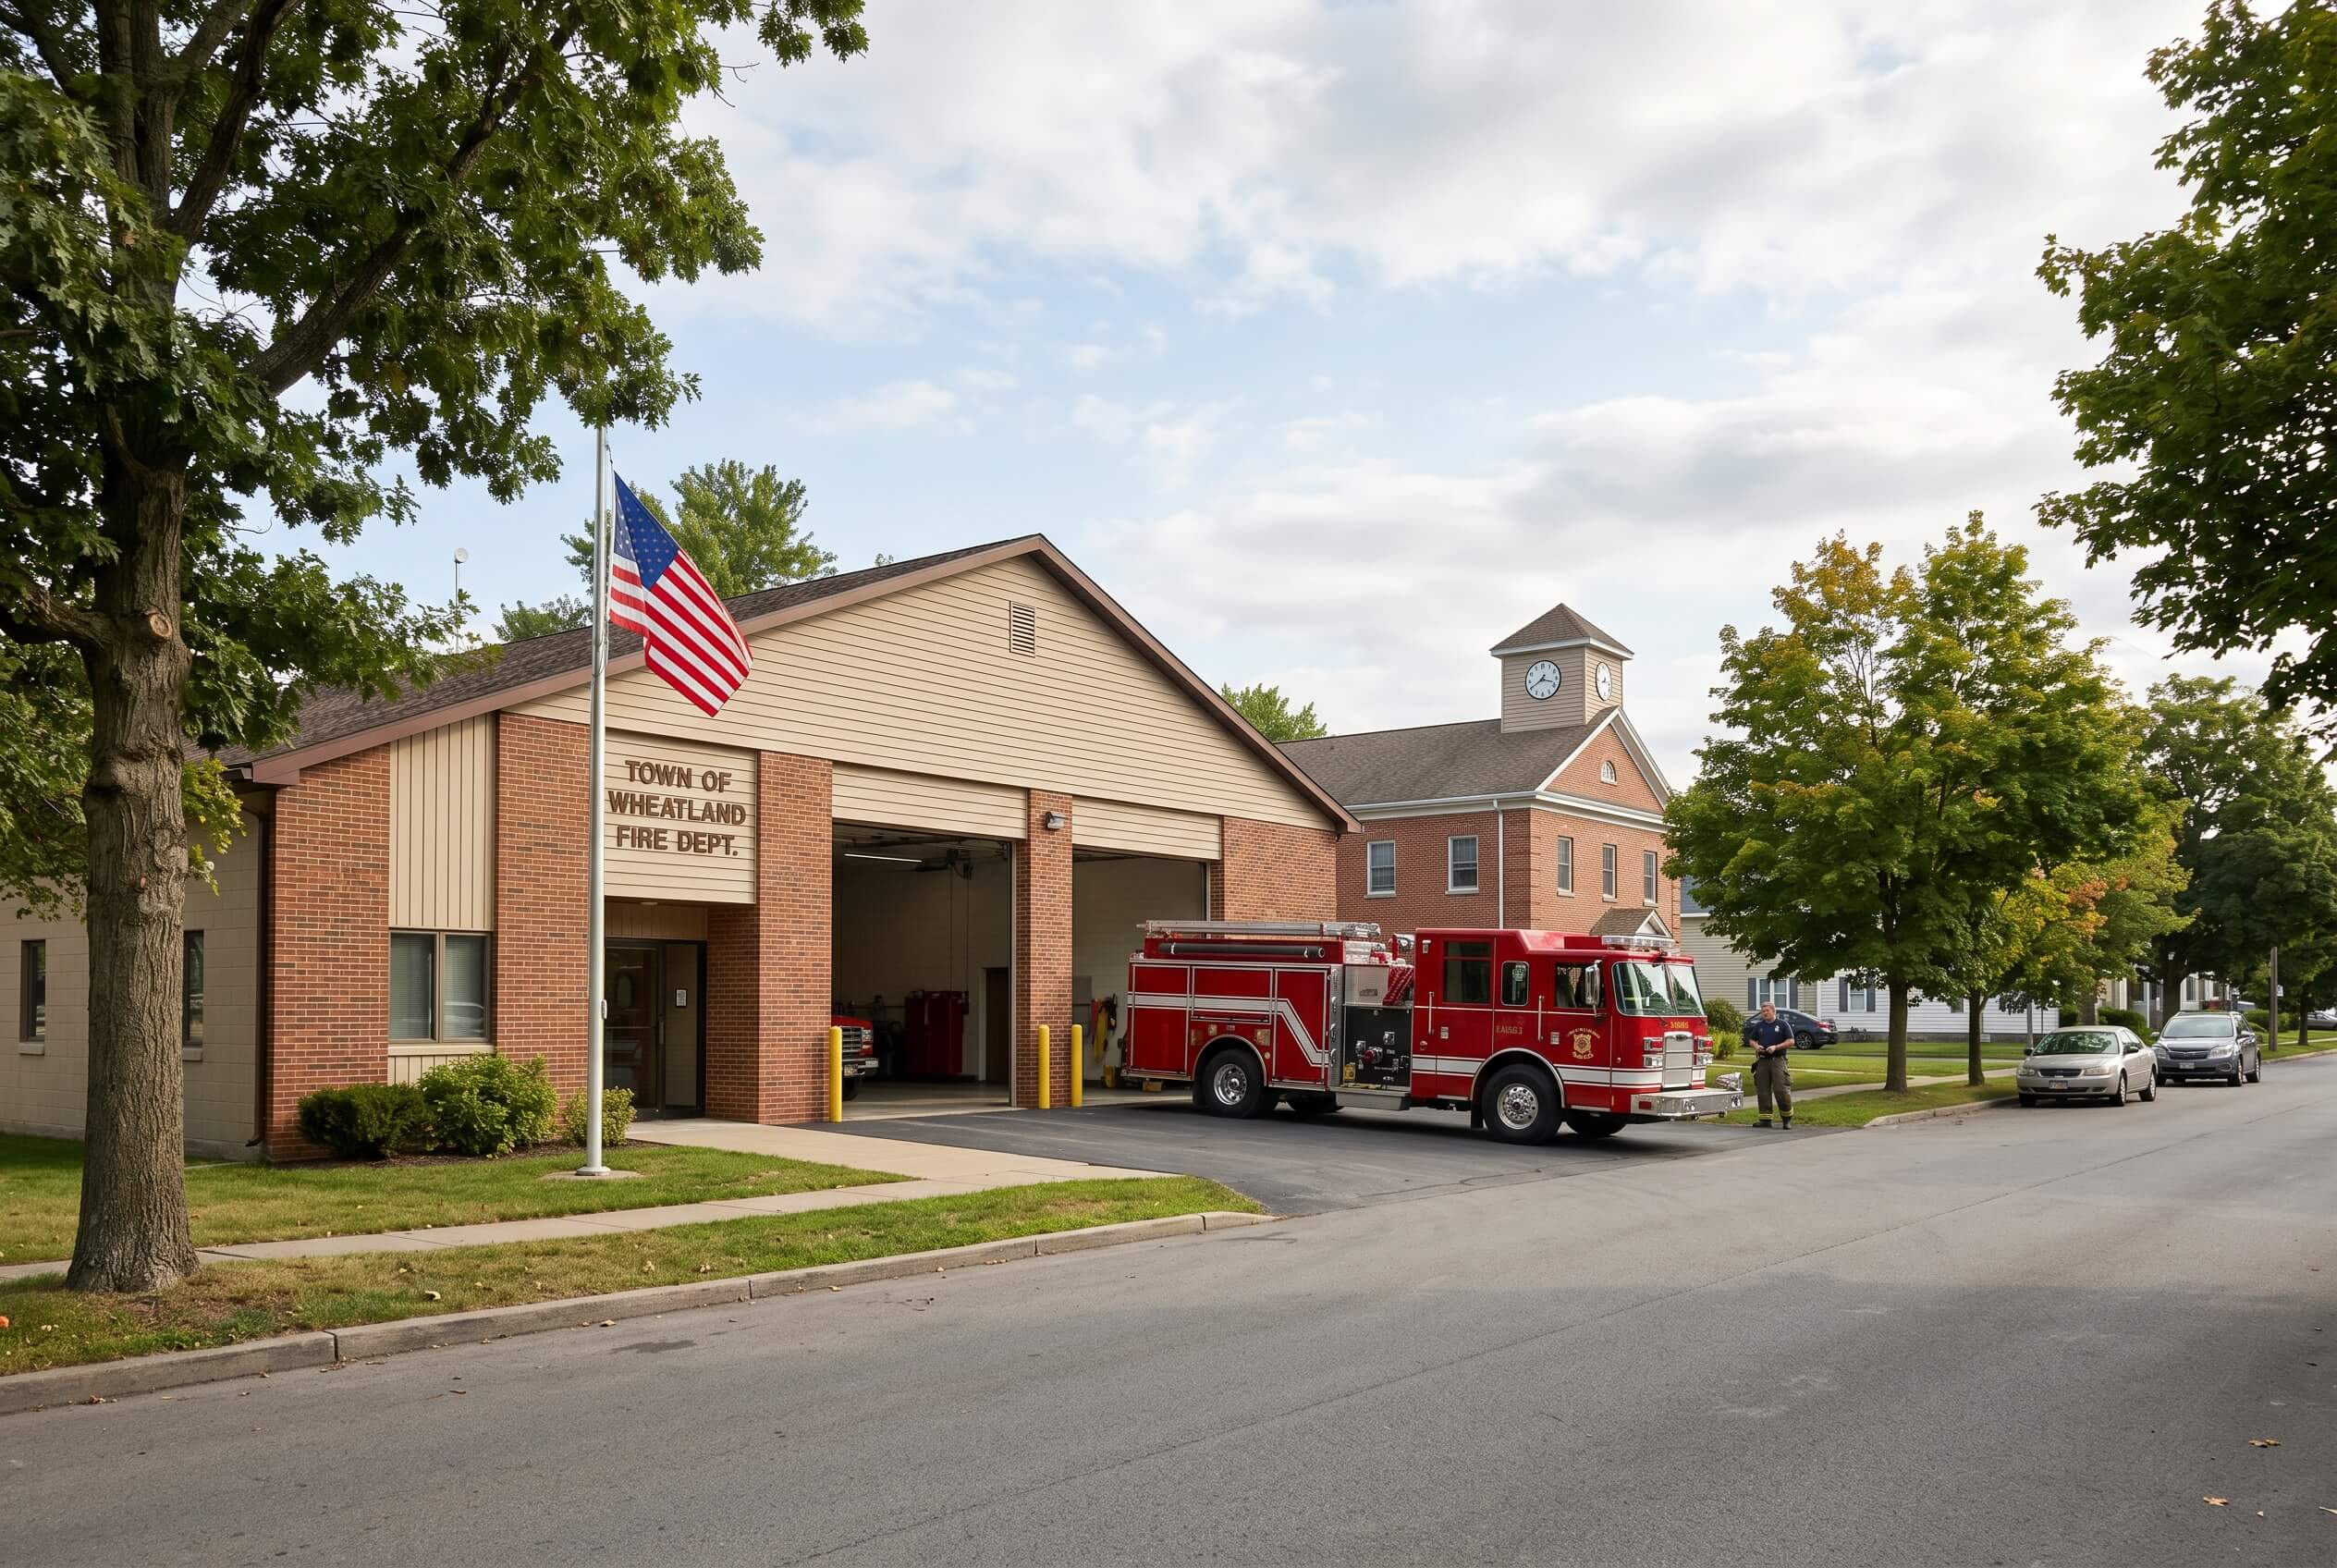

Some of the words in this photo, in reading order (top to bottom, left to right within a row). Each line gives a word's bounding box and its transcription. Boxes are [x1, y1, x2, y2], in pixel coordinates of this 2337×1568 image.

[625, 760, 692, 790] TOWN
[701, 770, 732, 793] OF
[607, 790, 747, 826] WHEATLAND
[617, 826, 668, 851] FIRE
[677, 830, 739, 856] DEPT.
